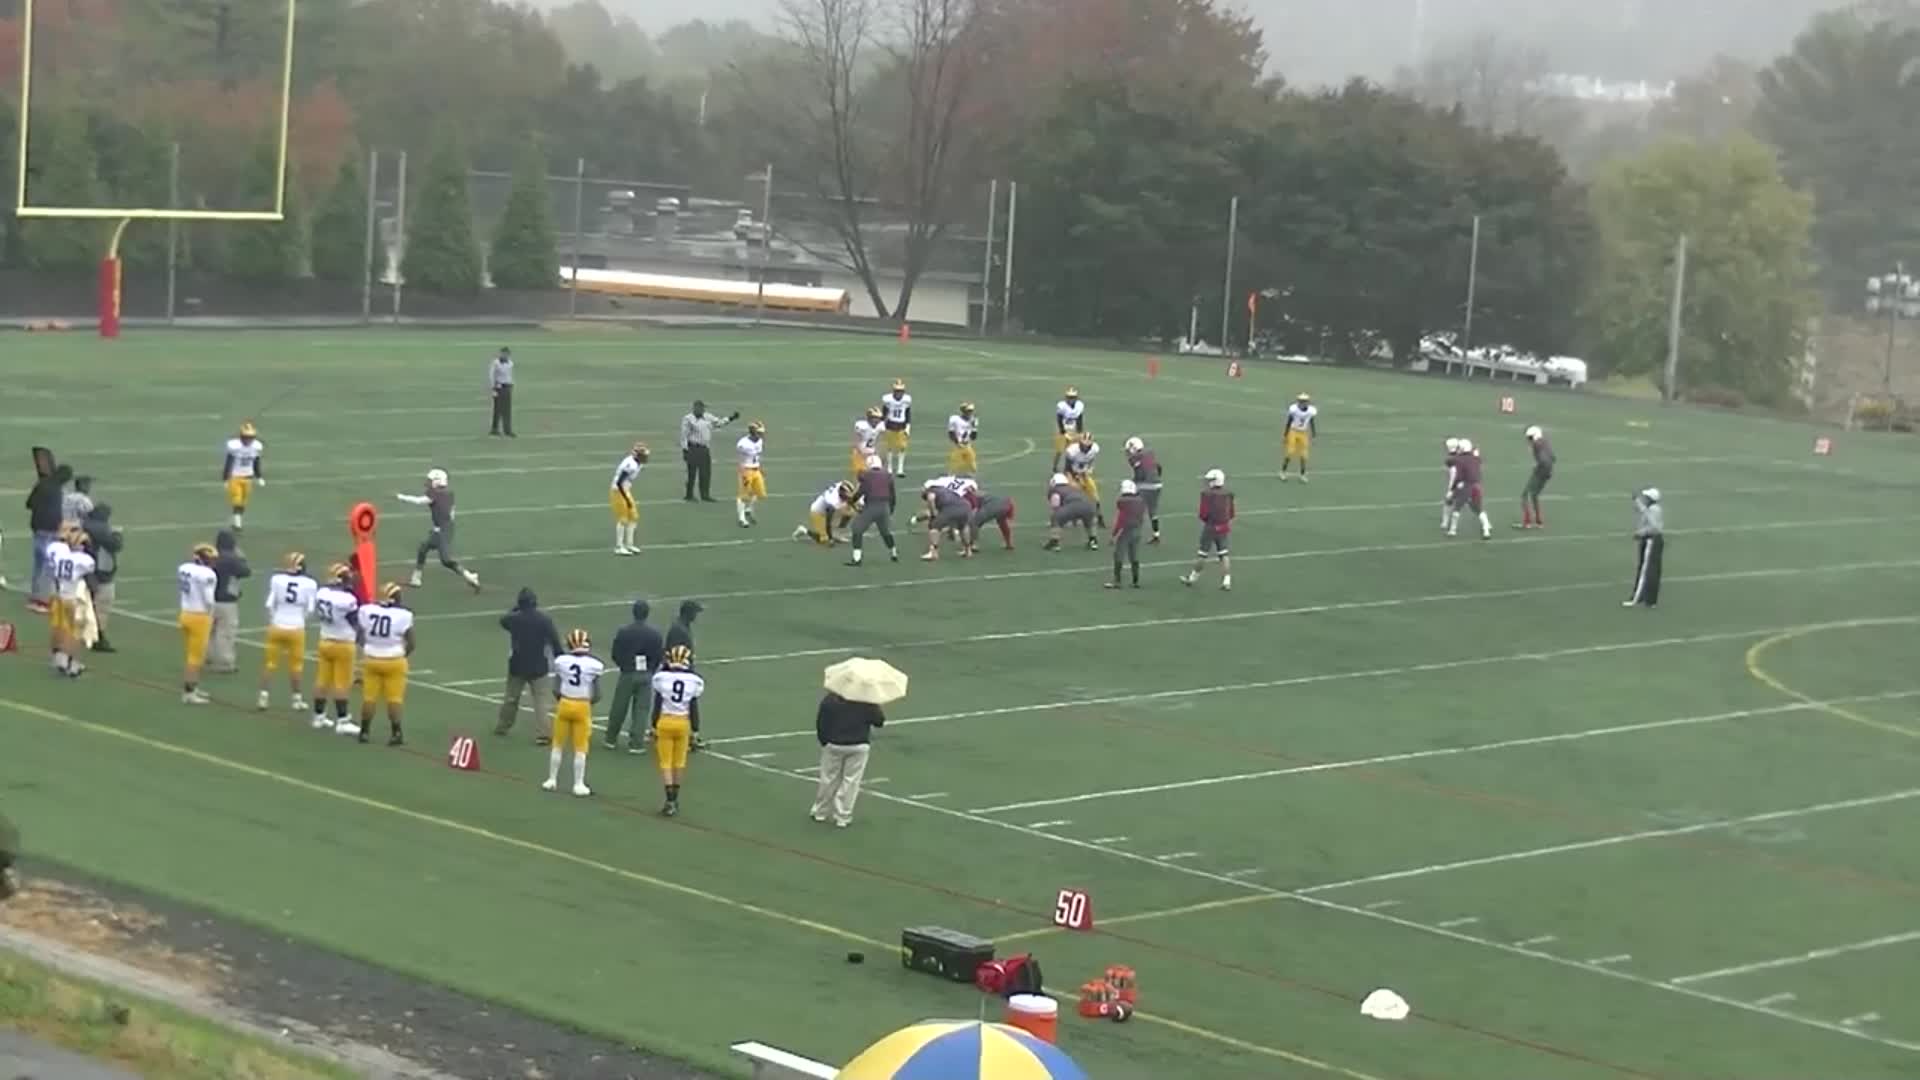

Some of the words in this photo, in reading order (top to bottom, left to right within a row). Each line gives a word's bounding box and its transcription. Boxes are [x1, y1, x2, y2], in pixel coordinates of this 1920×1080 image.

[57, 557, 75, 581] 19
[285, 581, 299, 604] 5
[317, 599, 333, 625] 53
[368, 613, 392, 638] 70
[568, 663, 582, 688] 3
[671, 679, 686, 704] 9
[449, 735, 474, 769] 40
[1055, 890, 1086, 928] 50
